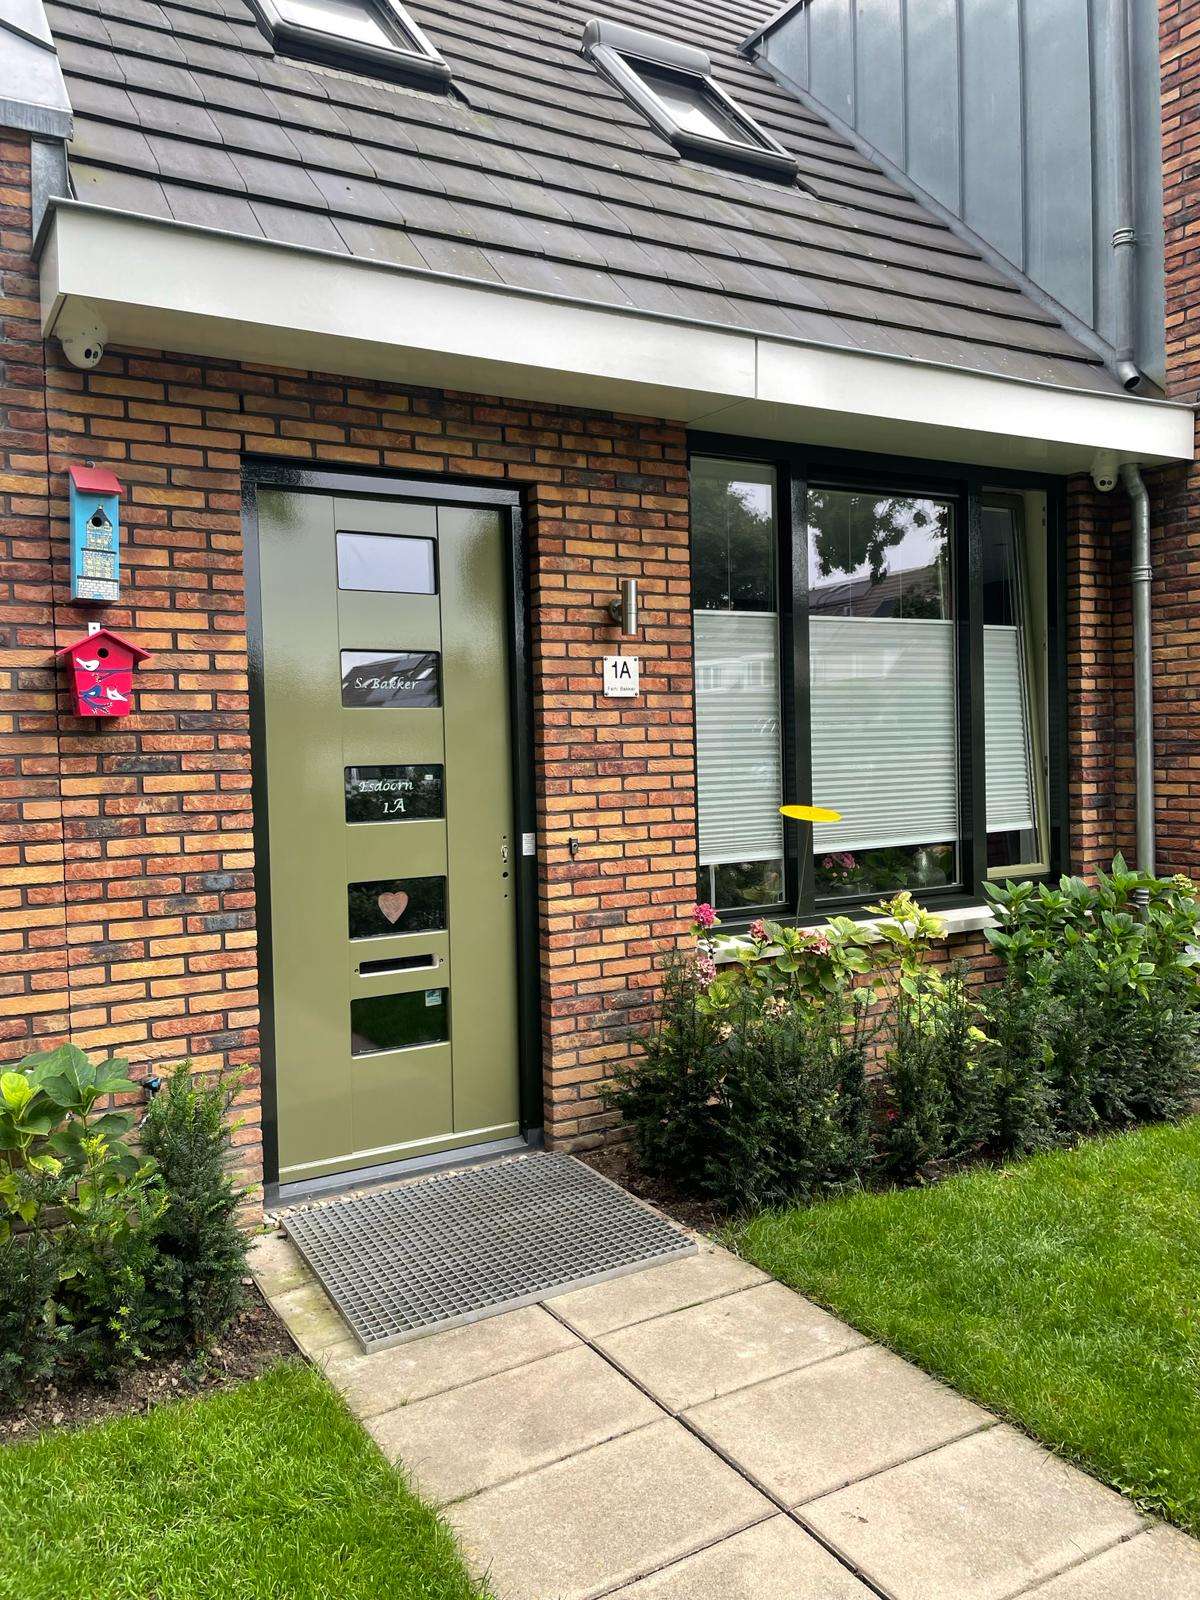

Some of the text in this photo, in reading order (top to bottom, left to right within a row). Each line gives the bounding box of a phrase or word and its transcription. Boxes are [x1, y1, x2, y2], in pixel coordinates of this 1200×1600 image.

[611, 661, 631, 679] 1A
[371, 676, 419, 690] Bakker
[358, 779, 414, 793] Esdoorn
[382, 798, 407, 814] 1A
